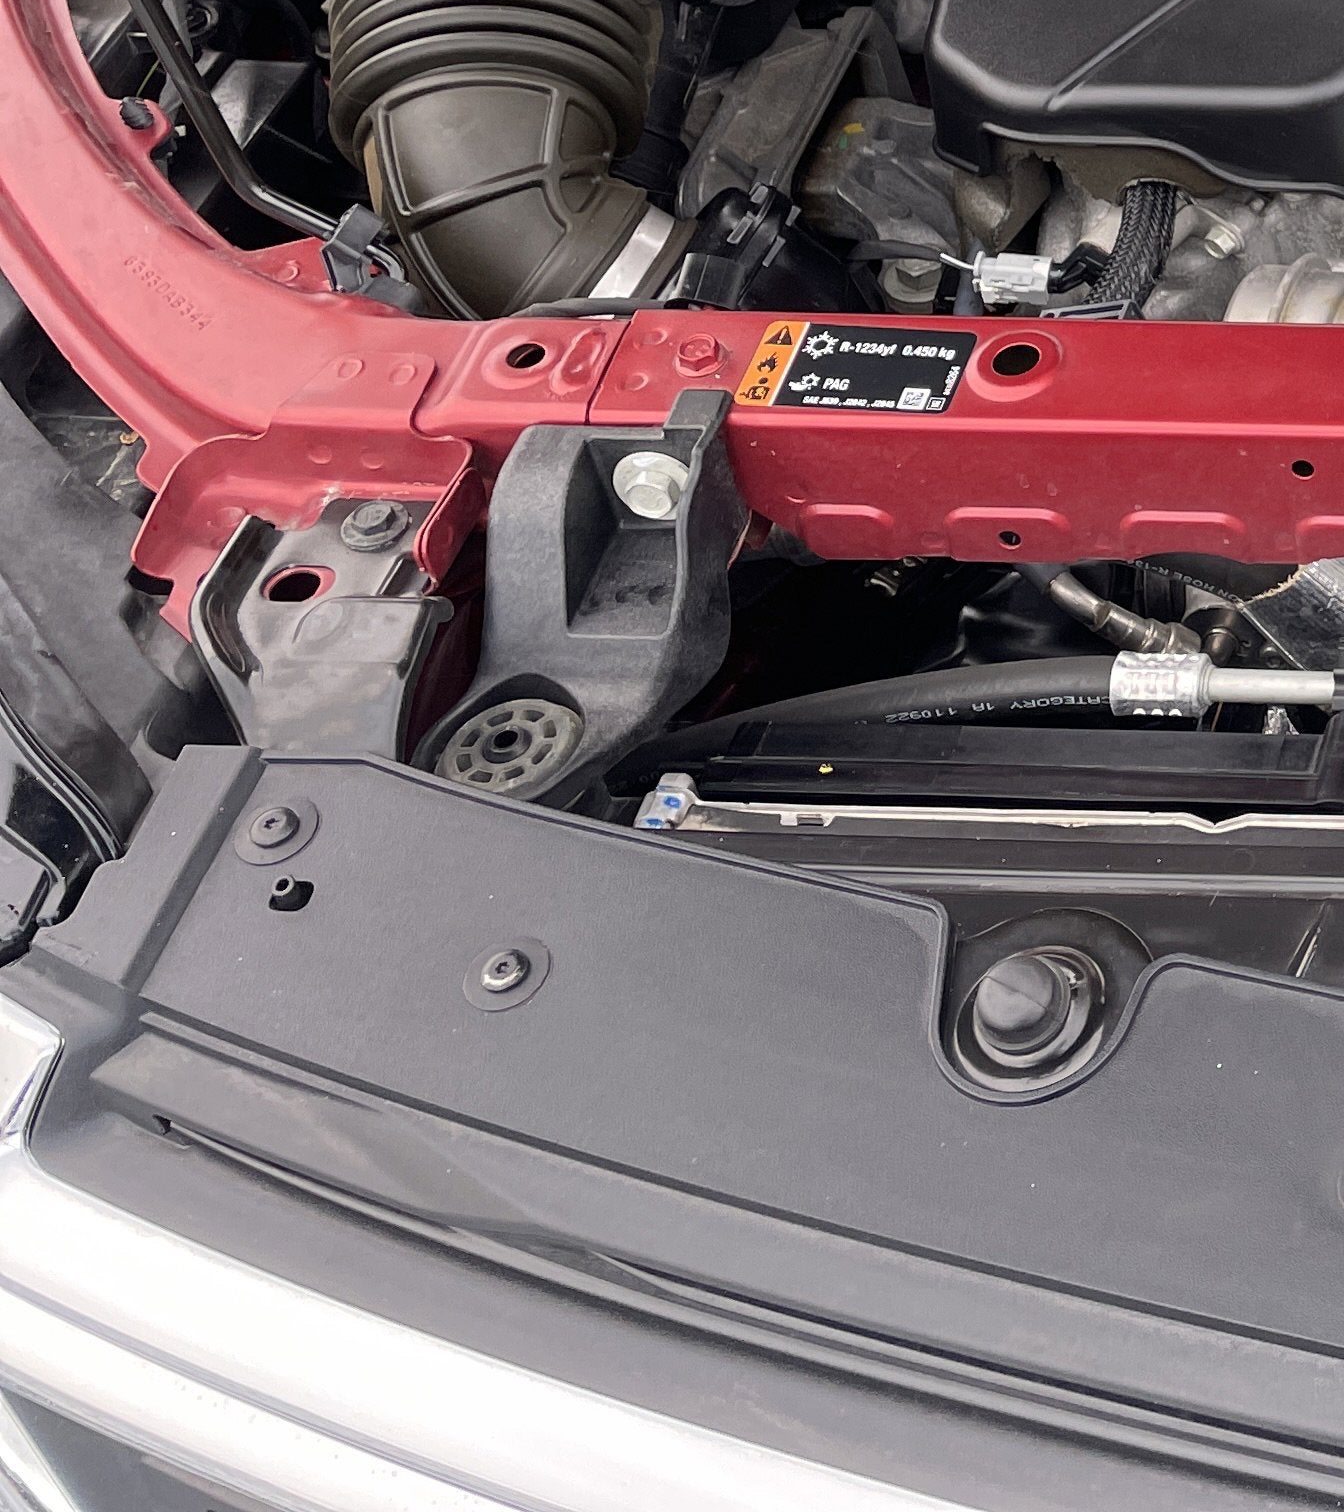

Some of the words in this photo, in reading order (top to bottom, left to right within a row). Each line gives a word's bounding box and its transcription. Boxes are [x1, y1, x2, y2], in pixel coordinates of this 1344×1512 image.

[839, 341, 898, 356] R-1234yf
[902, 345, 938, 358] 0.450
[937, 347, 956, 361] kg
[822, 377, 851, 391] PAG
